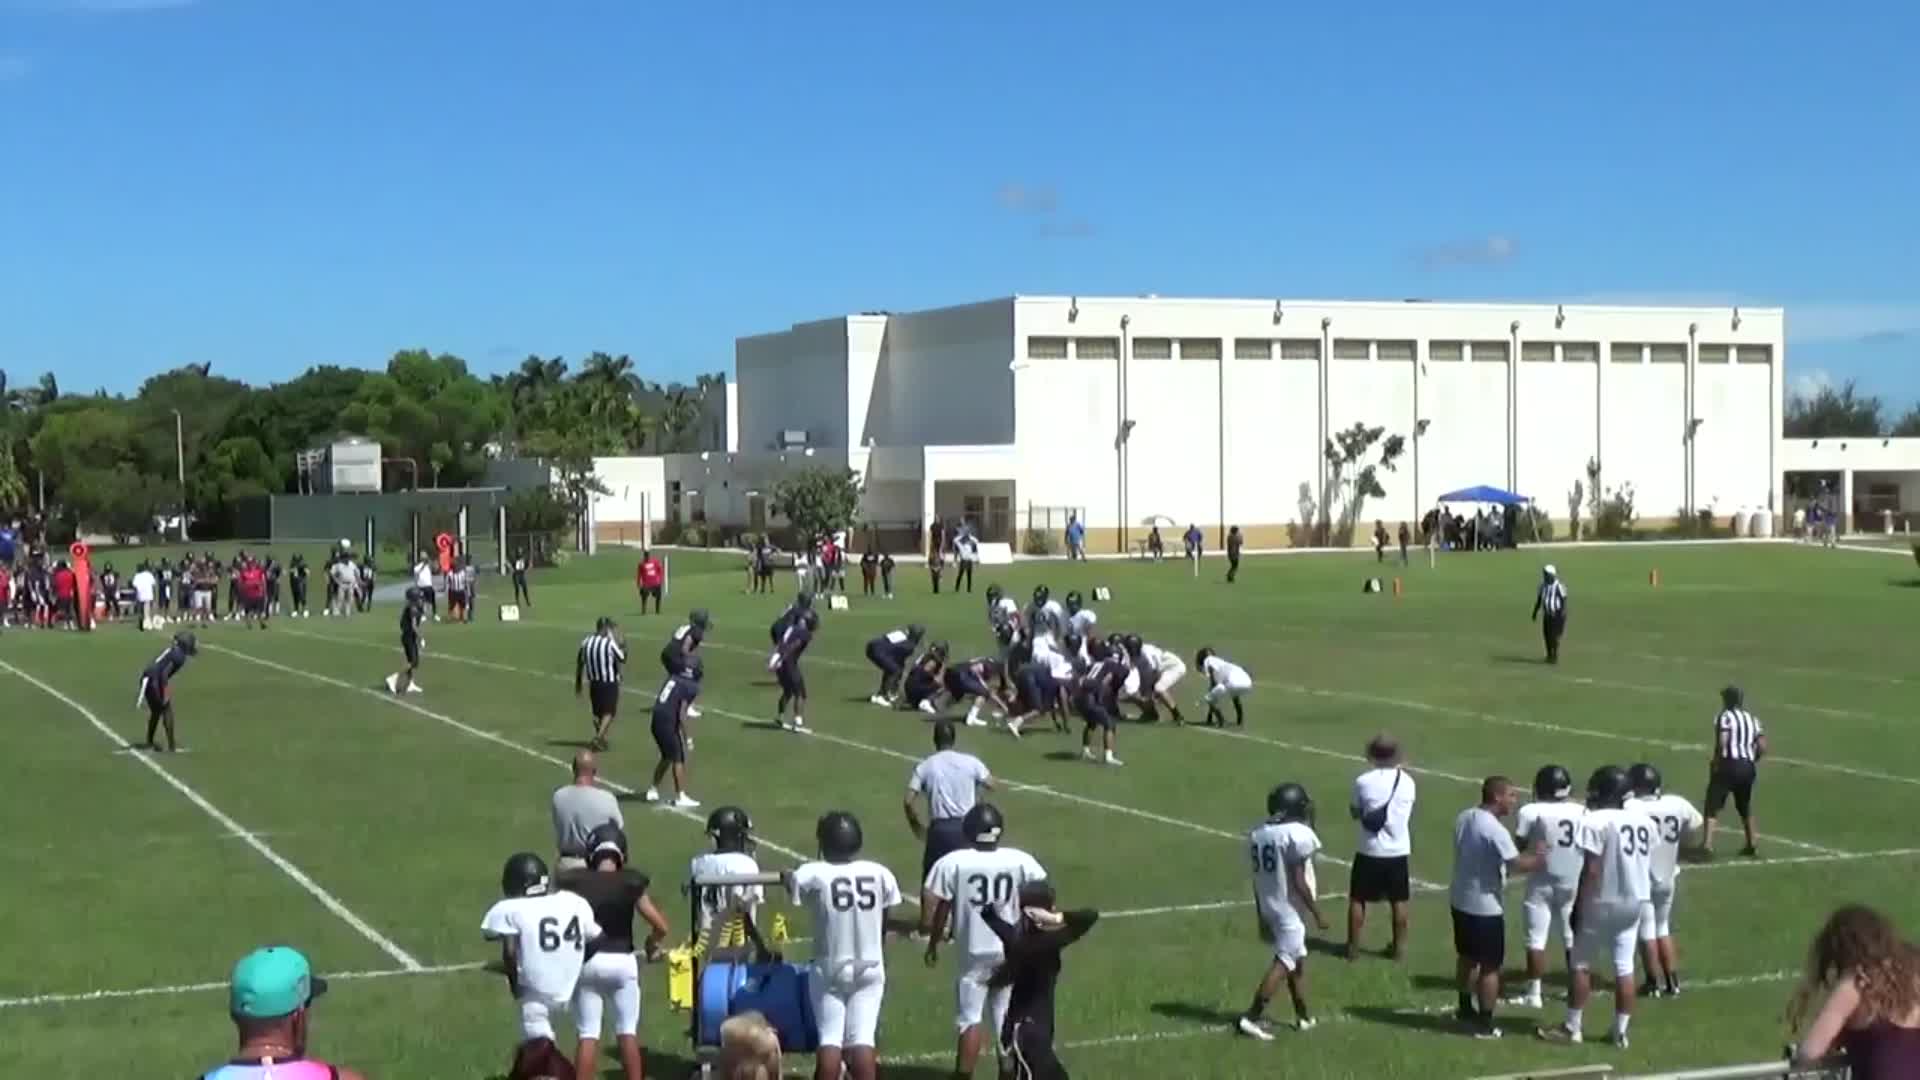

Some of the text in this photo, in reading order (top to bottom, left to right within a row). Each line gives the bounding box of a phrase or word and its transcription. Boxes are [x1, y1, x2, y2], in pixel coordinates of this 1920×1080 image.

[1620, 824, 1648, 855] 39
[831, 876, 875, 912] 65
[968, 872, 1012, 906] 30
[539, 915, 582, 951] 64
